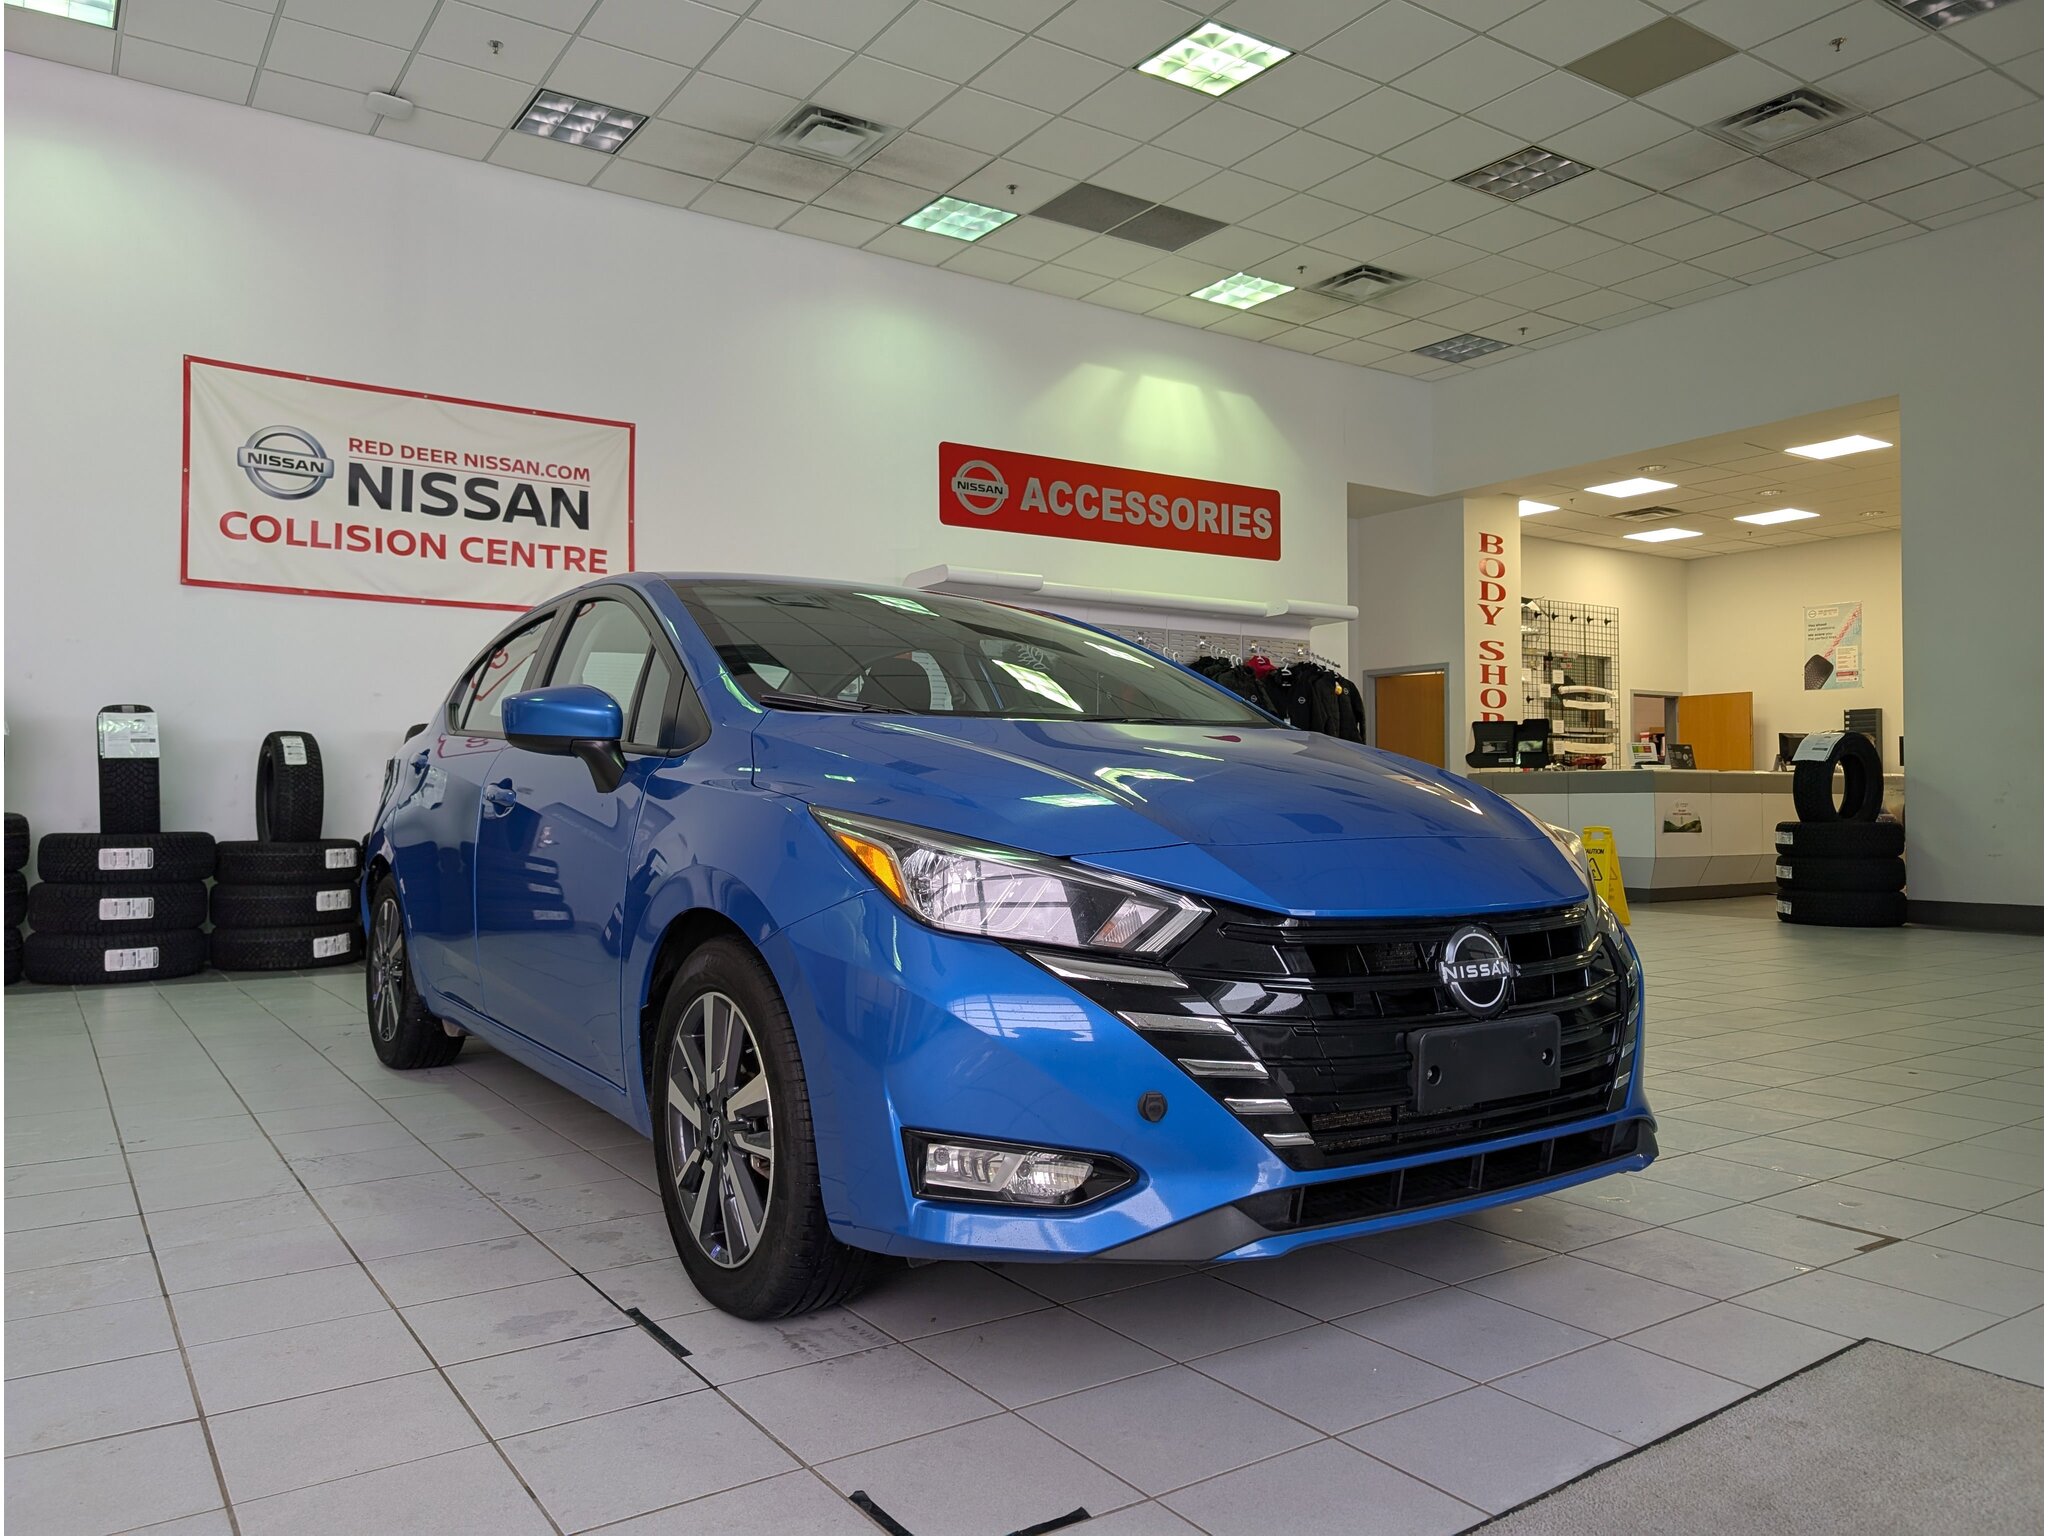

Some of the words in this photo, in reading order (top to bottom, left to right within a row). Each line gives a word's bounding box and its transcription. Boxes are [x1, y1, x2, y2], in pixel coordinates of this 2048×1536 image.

[247, 451, 325, 473] NISSAN
[348, 437, 394, 457] RED
[400, 445, 458, 466] DEER
[463, 453, 591, 482] NISSAN.COM
[347, 462, 590, 530] NISSAN
[957, 480, 1003, 495] NISSAN
[1020, 477, 1273, 540] ACCESSORIES
[219, 511, 446, 560] COLLISION
[460, 537, 608, 574] CENTRE
[1478, 532, 1507, 625] BODY
[1443, 960, 1509, 980] NISSAN
